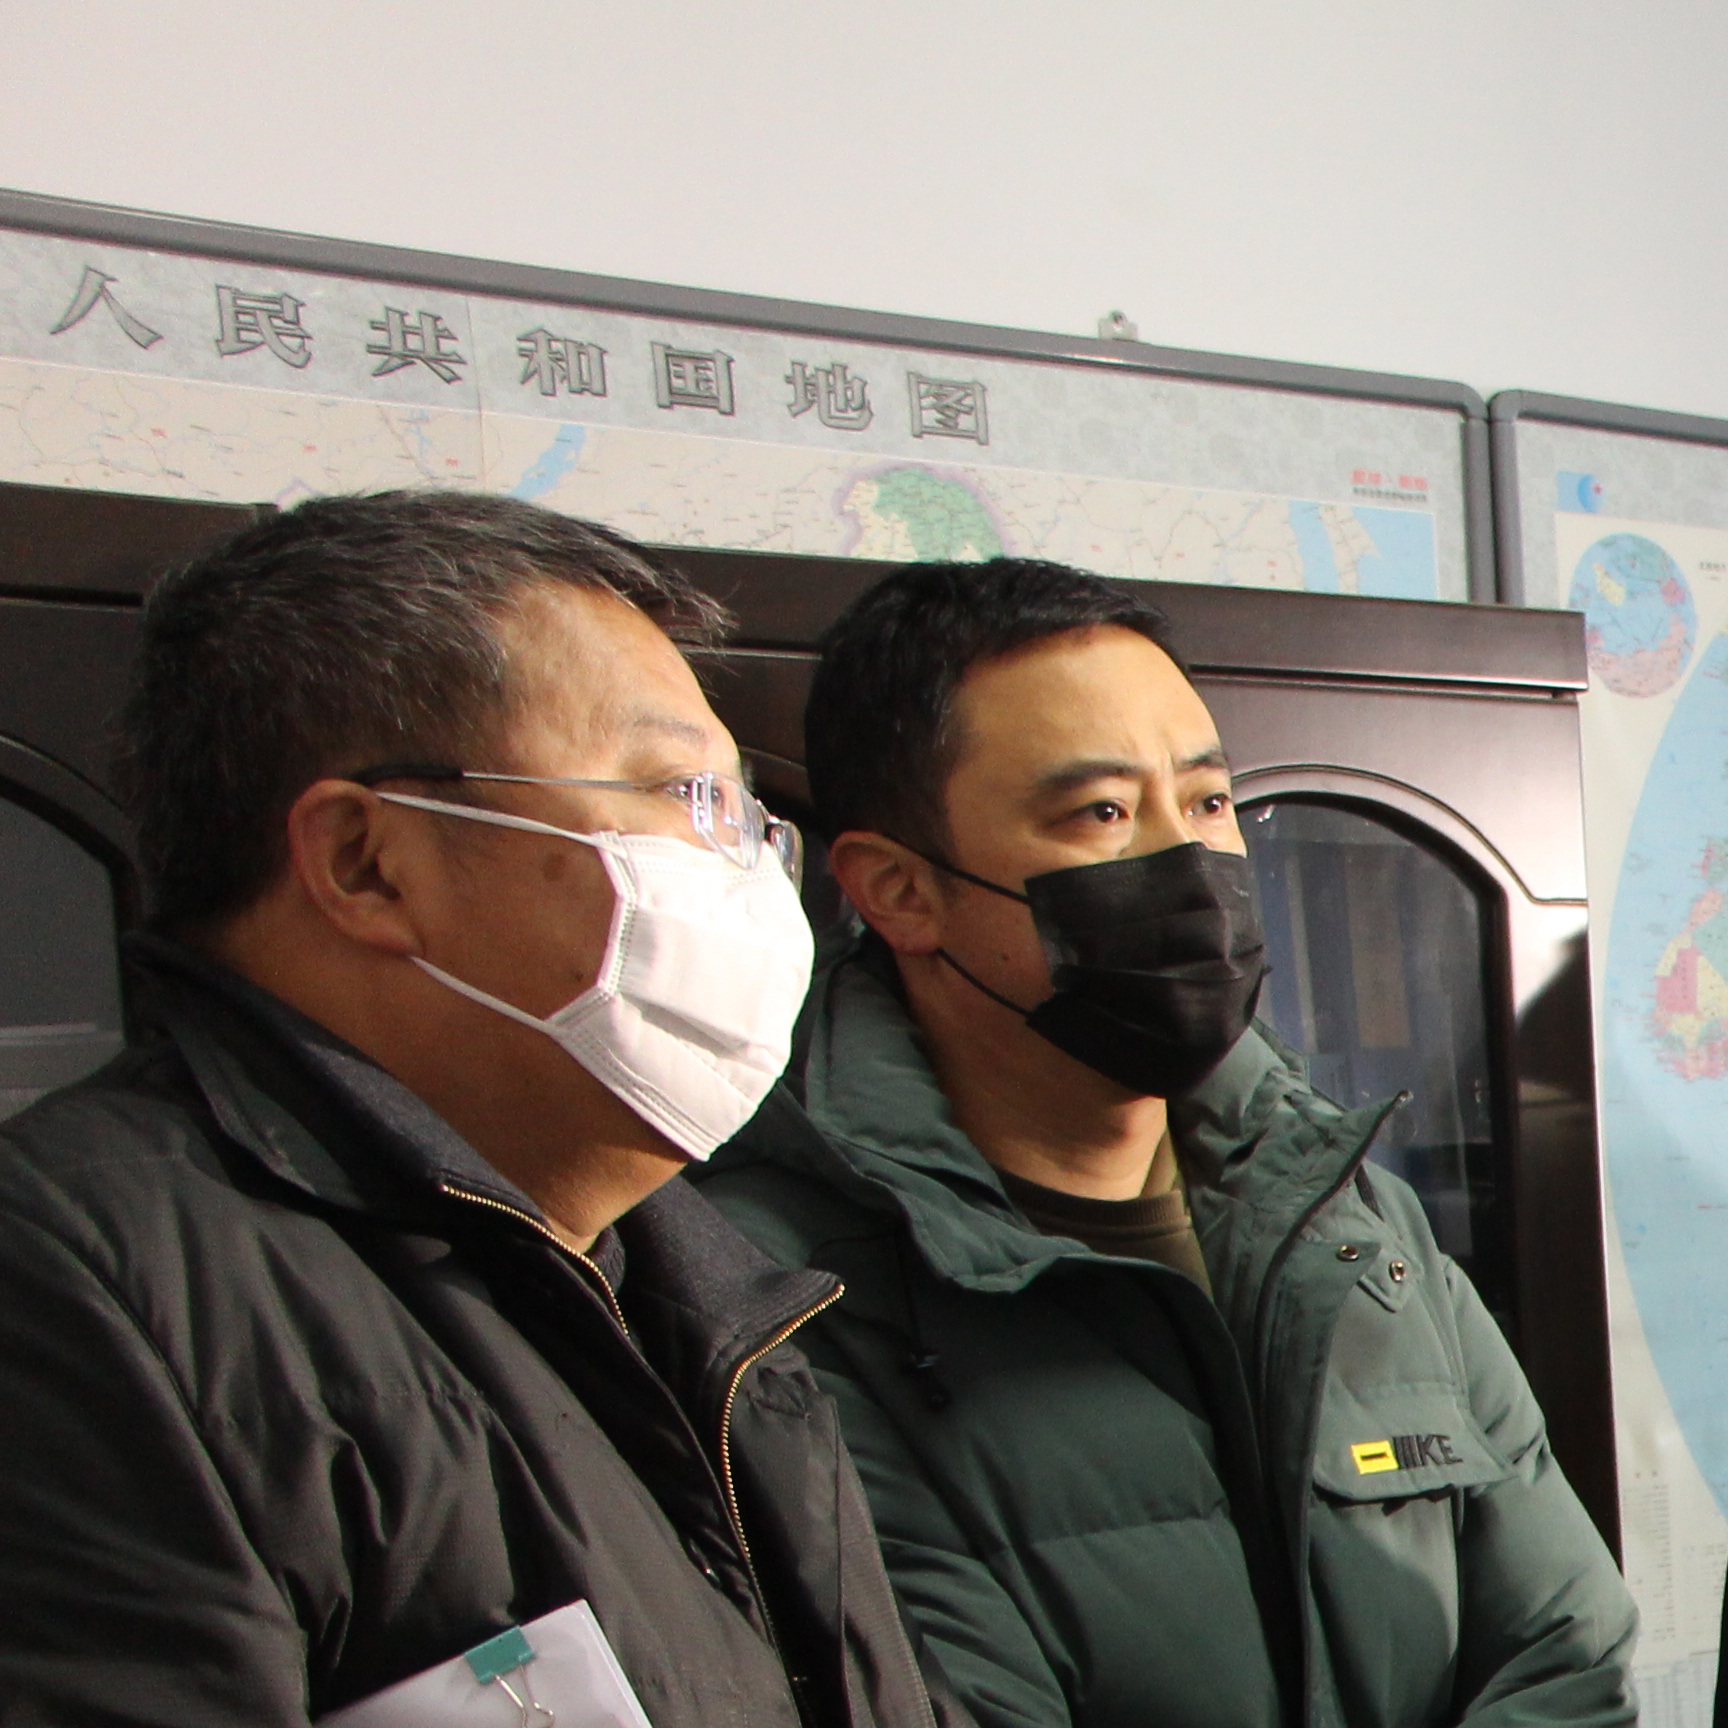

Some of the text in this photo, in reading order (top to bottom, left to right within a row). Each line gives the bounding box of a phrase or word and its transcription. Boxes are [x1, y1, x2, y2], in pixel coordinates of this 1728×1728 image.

[50, 264, 990, 446] 人民共和国地图
